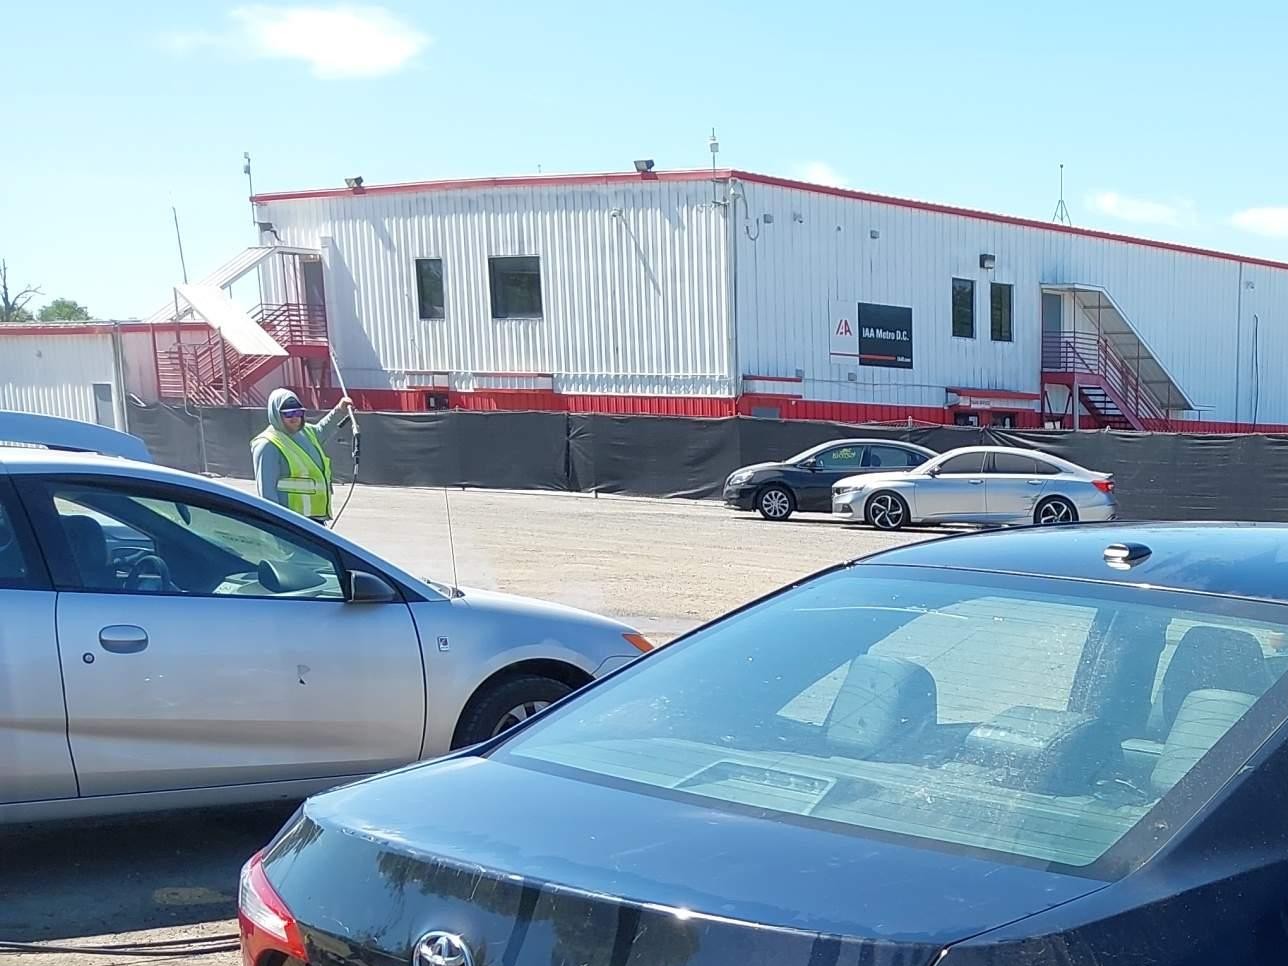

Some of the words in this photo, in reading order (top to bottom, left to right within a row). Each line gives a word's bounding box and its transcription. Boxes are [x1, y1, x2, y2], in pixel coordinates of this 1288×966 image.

[862, 327, 875, 338] IAA
[875, 328, 895, 340] Metro
[896, 330, 910, 341] D.C.
